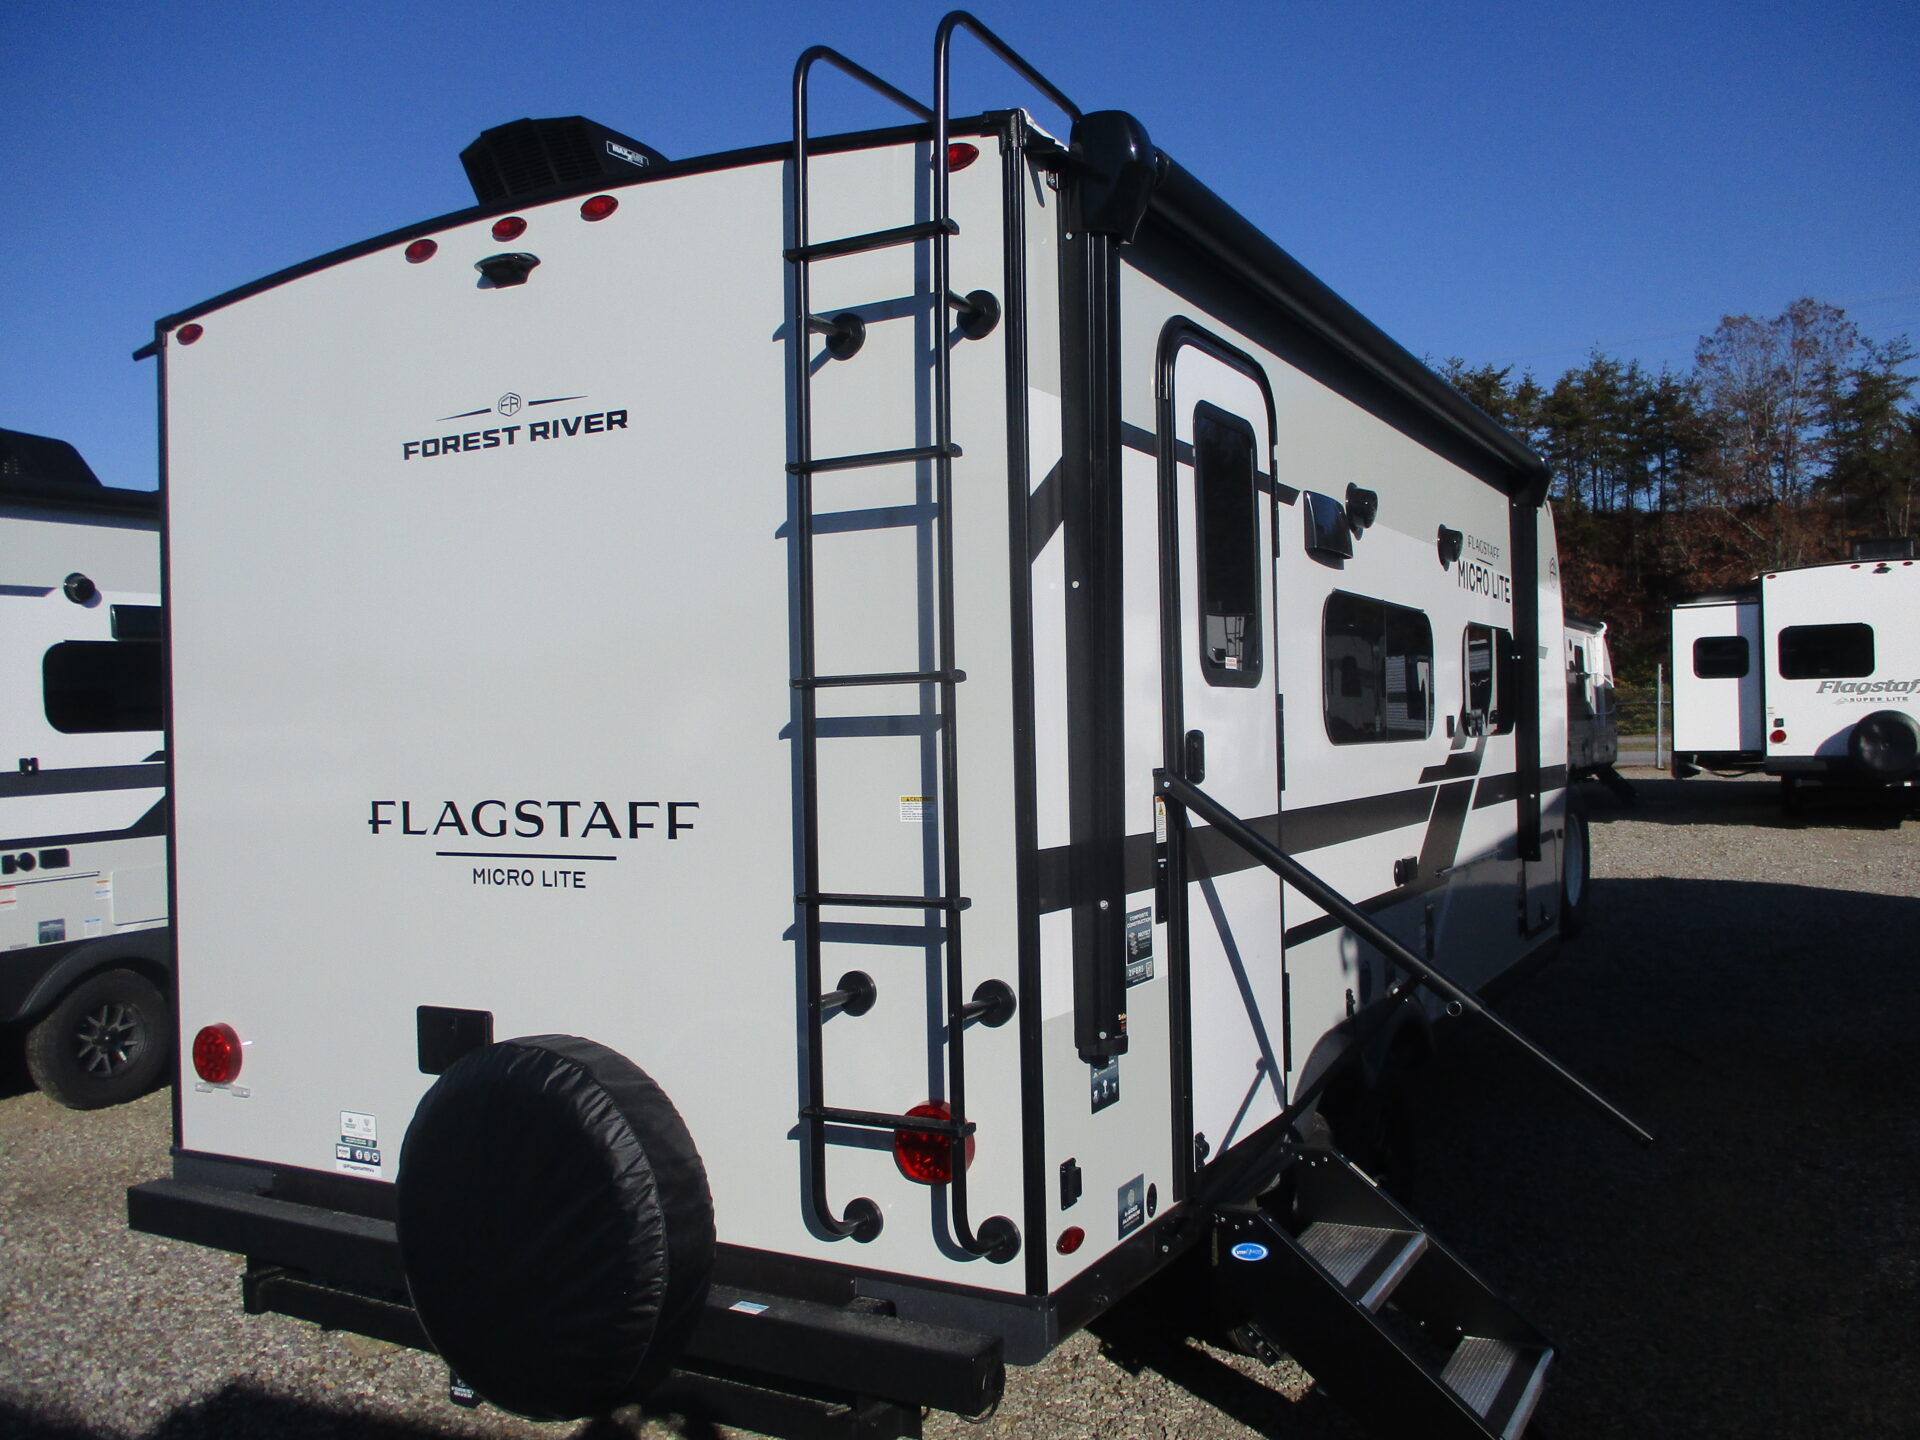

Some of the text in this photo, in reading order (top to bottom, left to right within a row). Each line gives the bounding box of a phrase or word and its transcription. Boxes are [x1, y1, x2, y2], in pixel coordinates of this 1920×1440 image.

[402, 409, 628, 460] FOREST RIVER
[1467, 534, 1500, 560] FLAGSTAFF
[1457, 559, 1511, 604] MICRO LITE
[1816, 679, 1920, 695] Flagstaf
[368, 799, 700, 840] FLAGSTAFF
[472, 868, 586, 889] MICRO LITE
